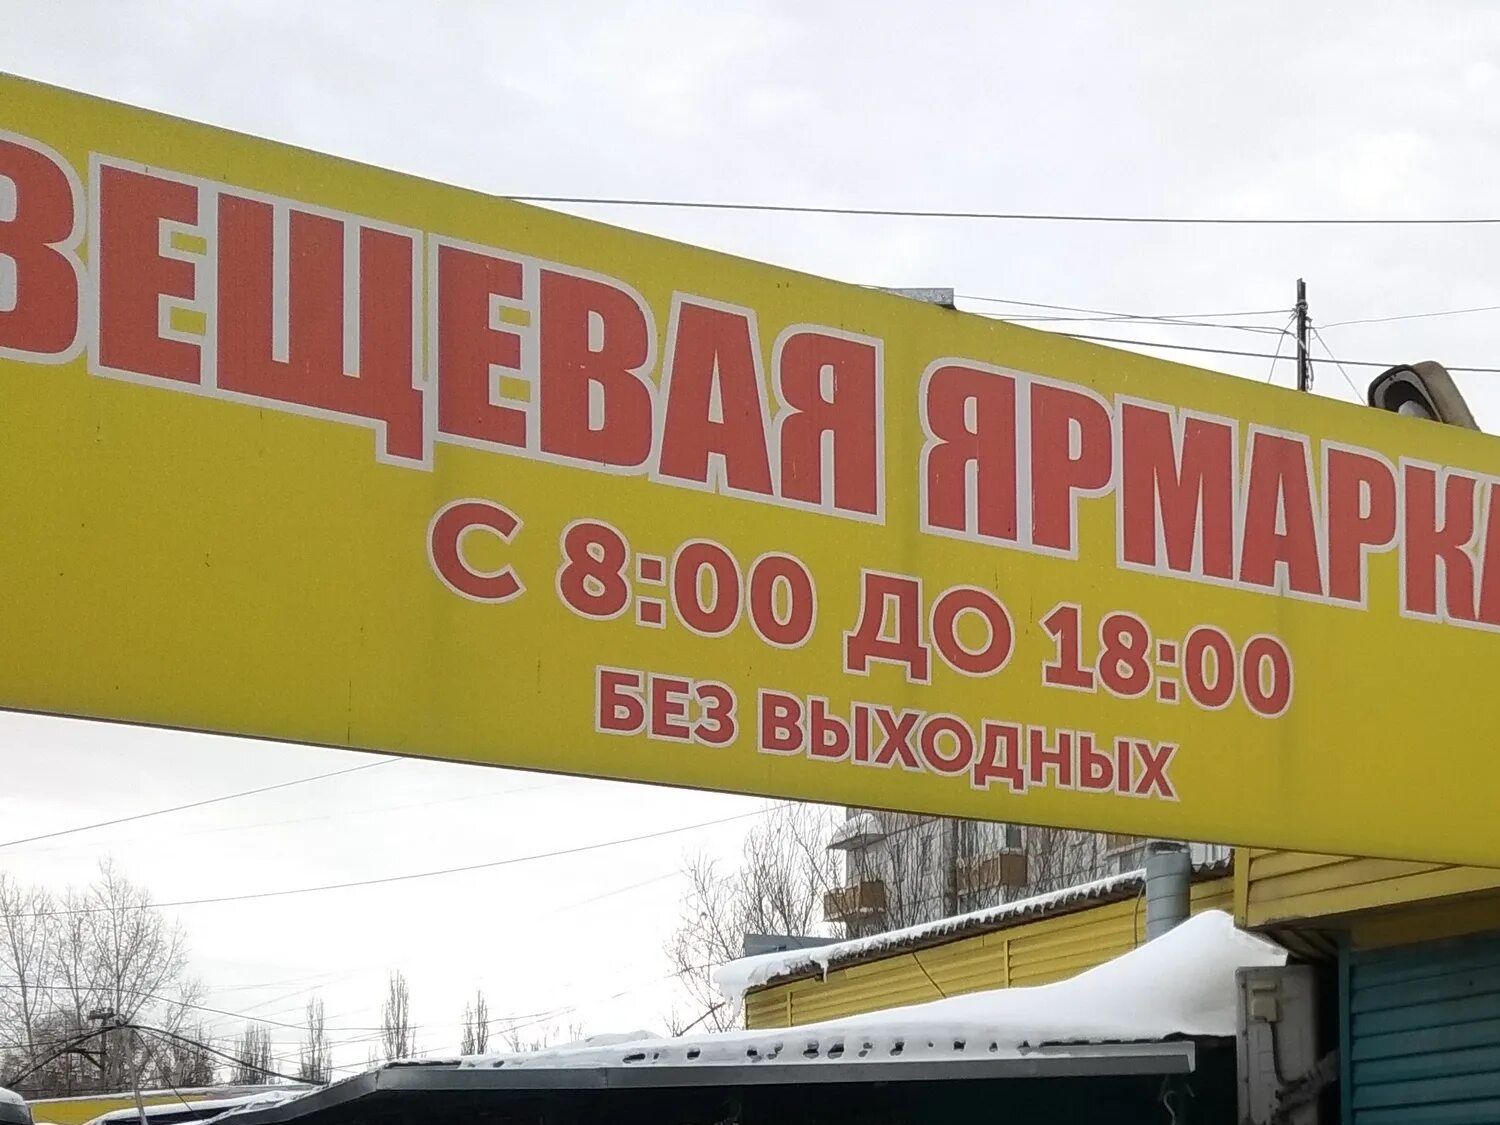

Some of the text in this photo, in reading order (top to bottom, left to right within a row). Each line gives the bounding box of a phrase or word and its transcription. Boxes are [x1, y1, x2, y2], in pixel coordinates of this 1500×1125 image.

[0, 136, 881, 520] ВЕЩЕВАЯ
[430, 501, 1292, 717] С 8:00 ДО 18:00
[598, 669, 1178, 799] БЕЗ ВЫХОДНЫХ
